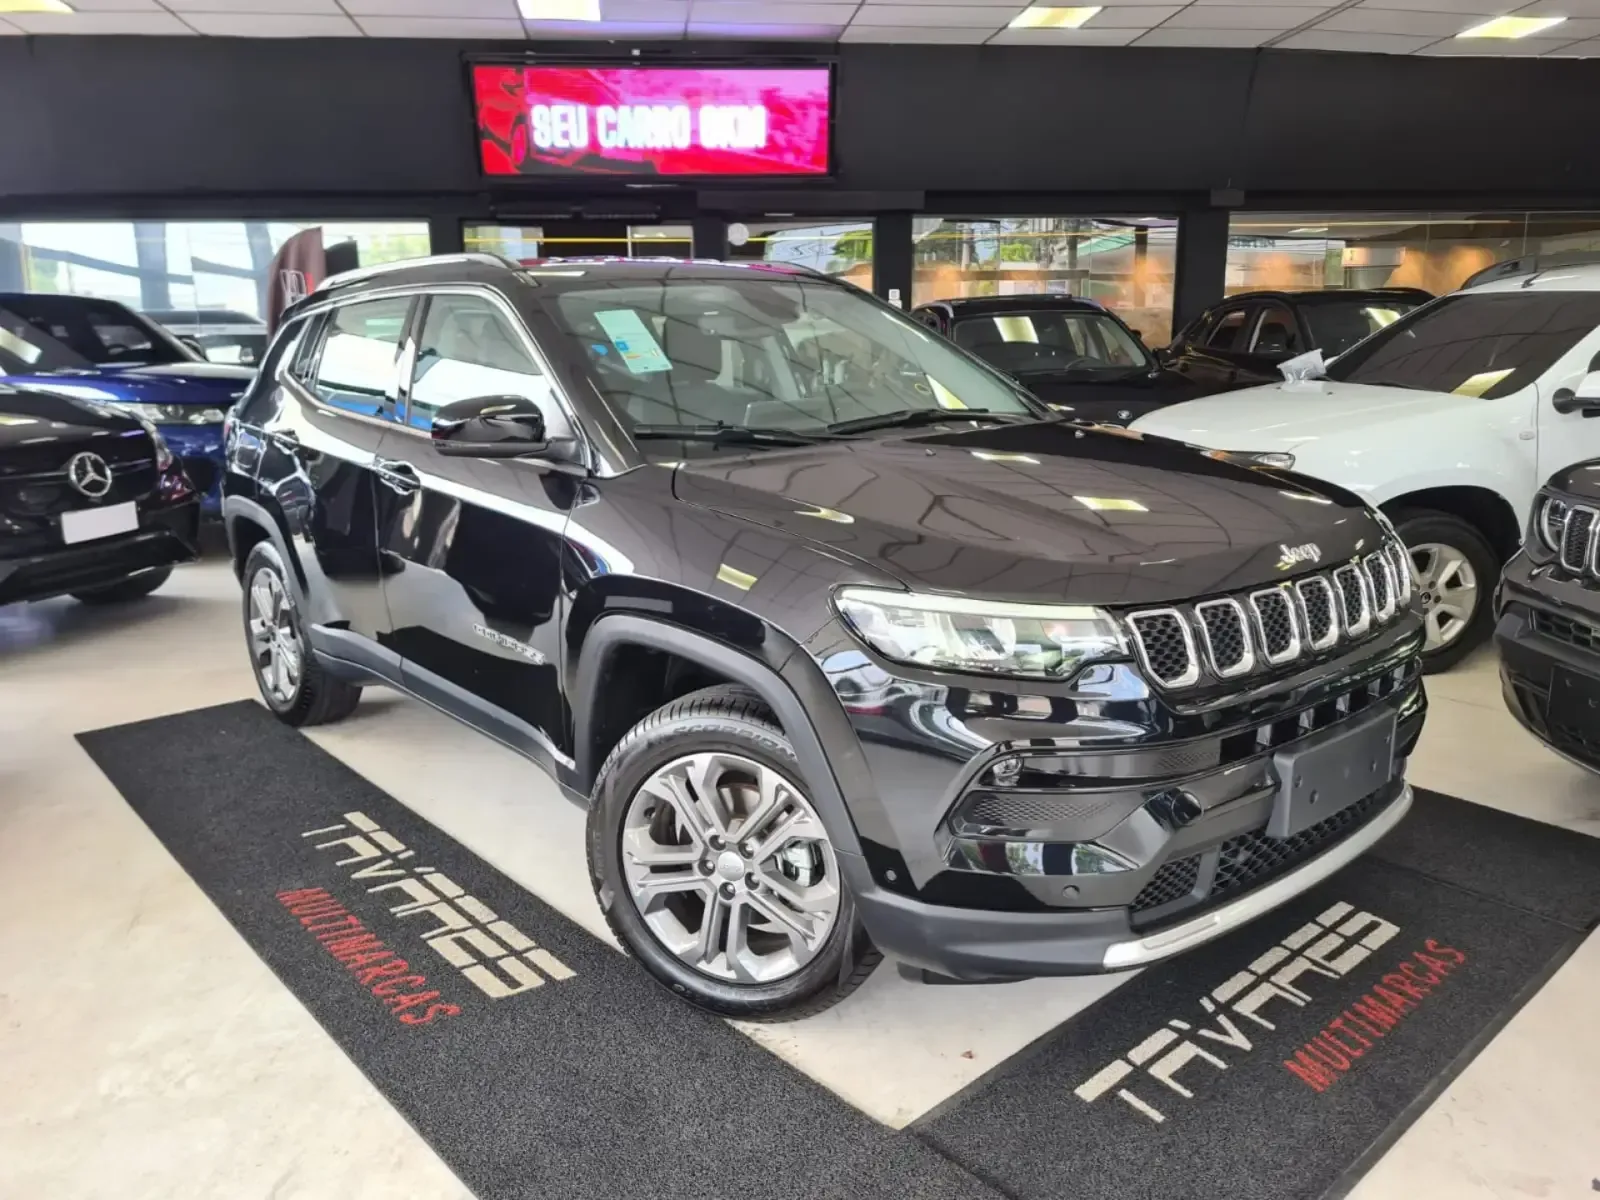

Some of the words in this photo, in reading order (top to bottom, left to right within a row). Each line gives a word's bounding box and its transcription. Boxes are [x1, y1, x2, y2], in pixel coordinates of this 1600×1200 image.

[532, 105, 588, 148] SEU
[597, 105, 691, 148] CARRO
[1280, 543, 1322, 563] Jeep
[276, 887, 463, 1026] MULTIMARCAS
[301, 811, 577, 999] TAVARES
[1073, 901, 1400, 1123] TAVARES
[1284, 938, 1466, 1094] MULTIMARCAS
